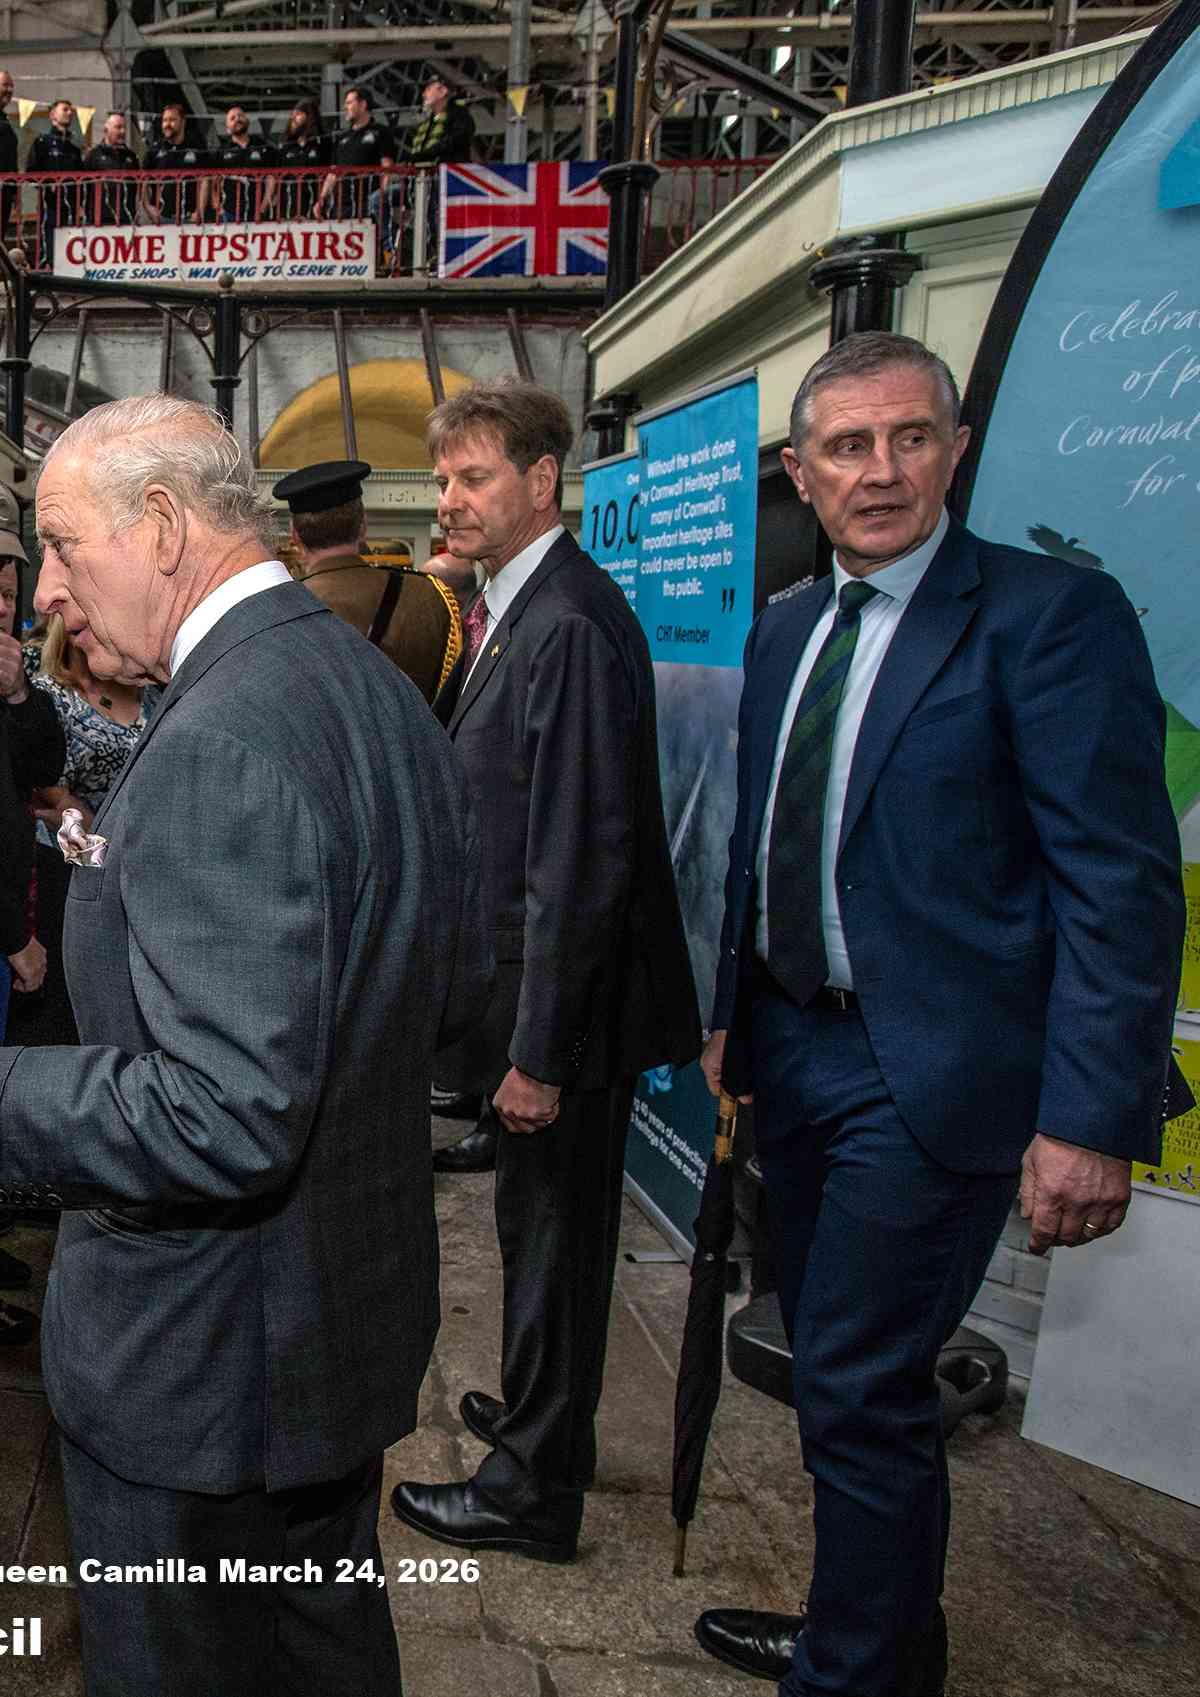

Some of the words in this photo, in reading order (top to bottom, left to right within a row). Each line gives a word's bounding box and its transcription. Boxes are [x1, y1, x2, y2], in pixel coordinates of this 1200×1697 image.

[65, 235, 166, 265] COME
[179, 231, 365, 263] UPSTAIRS
[84, 267, 128, 281] MORE
[129, 267, 179, 281] SHOPS
[188, 265, 258, 280] WAITING
[262, 264, 282, 277] TO
[287, 264, 337, 277] SERVE
[340, 264, 369, 277] YOU
[1059, 289, 1200, 352] Celebra
[1122, 344, 1192, 404] of
[711, 438, 737, 459] done
[650, 476, 684, 503] Cornwall
[684, 471, 720, 493] Heritage
[1115, 454, 1189, 511] for
[714, 519, 735, 540] sites
[640, 556, 662, 575] could
[663, 557, 686, 573] never
[686, 551, 699, 570] be
[699, 552, 722, 573] open
[723, 547, 734, 567] to
[674, 624, 711, 644] Member
